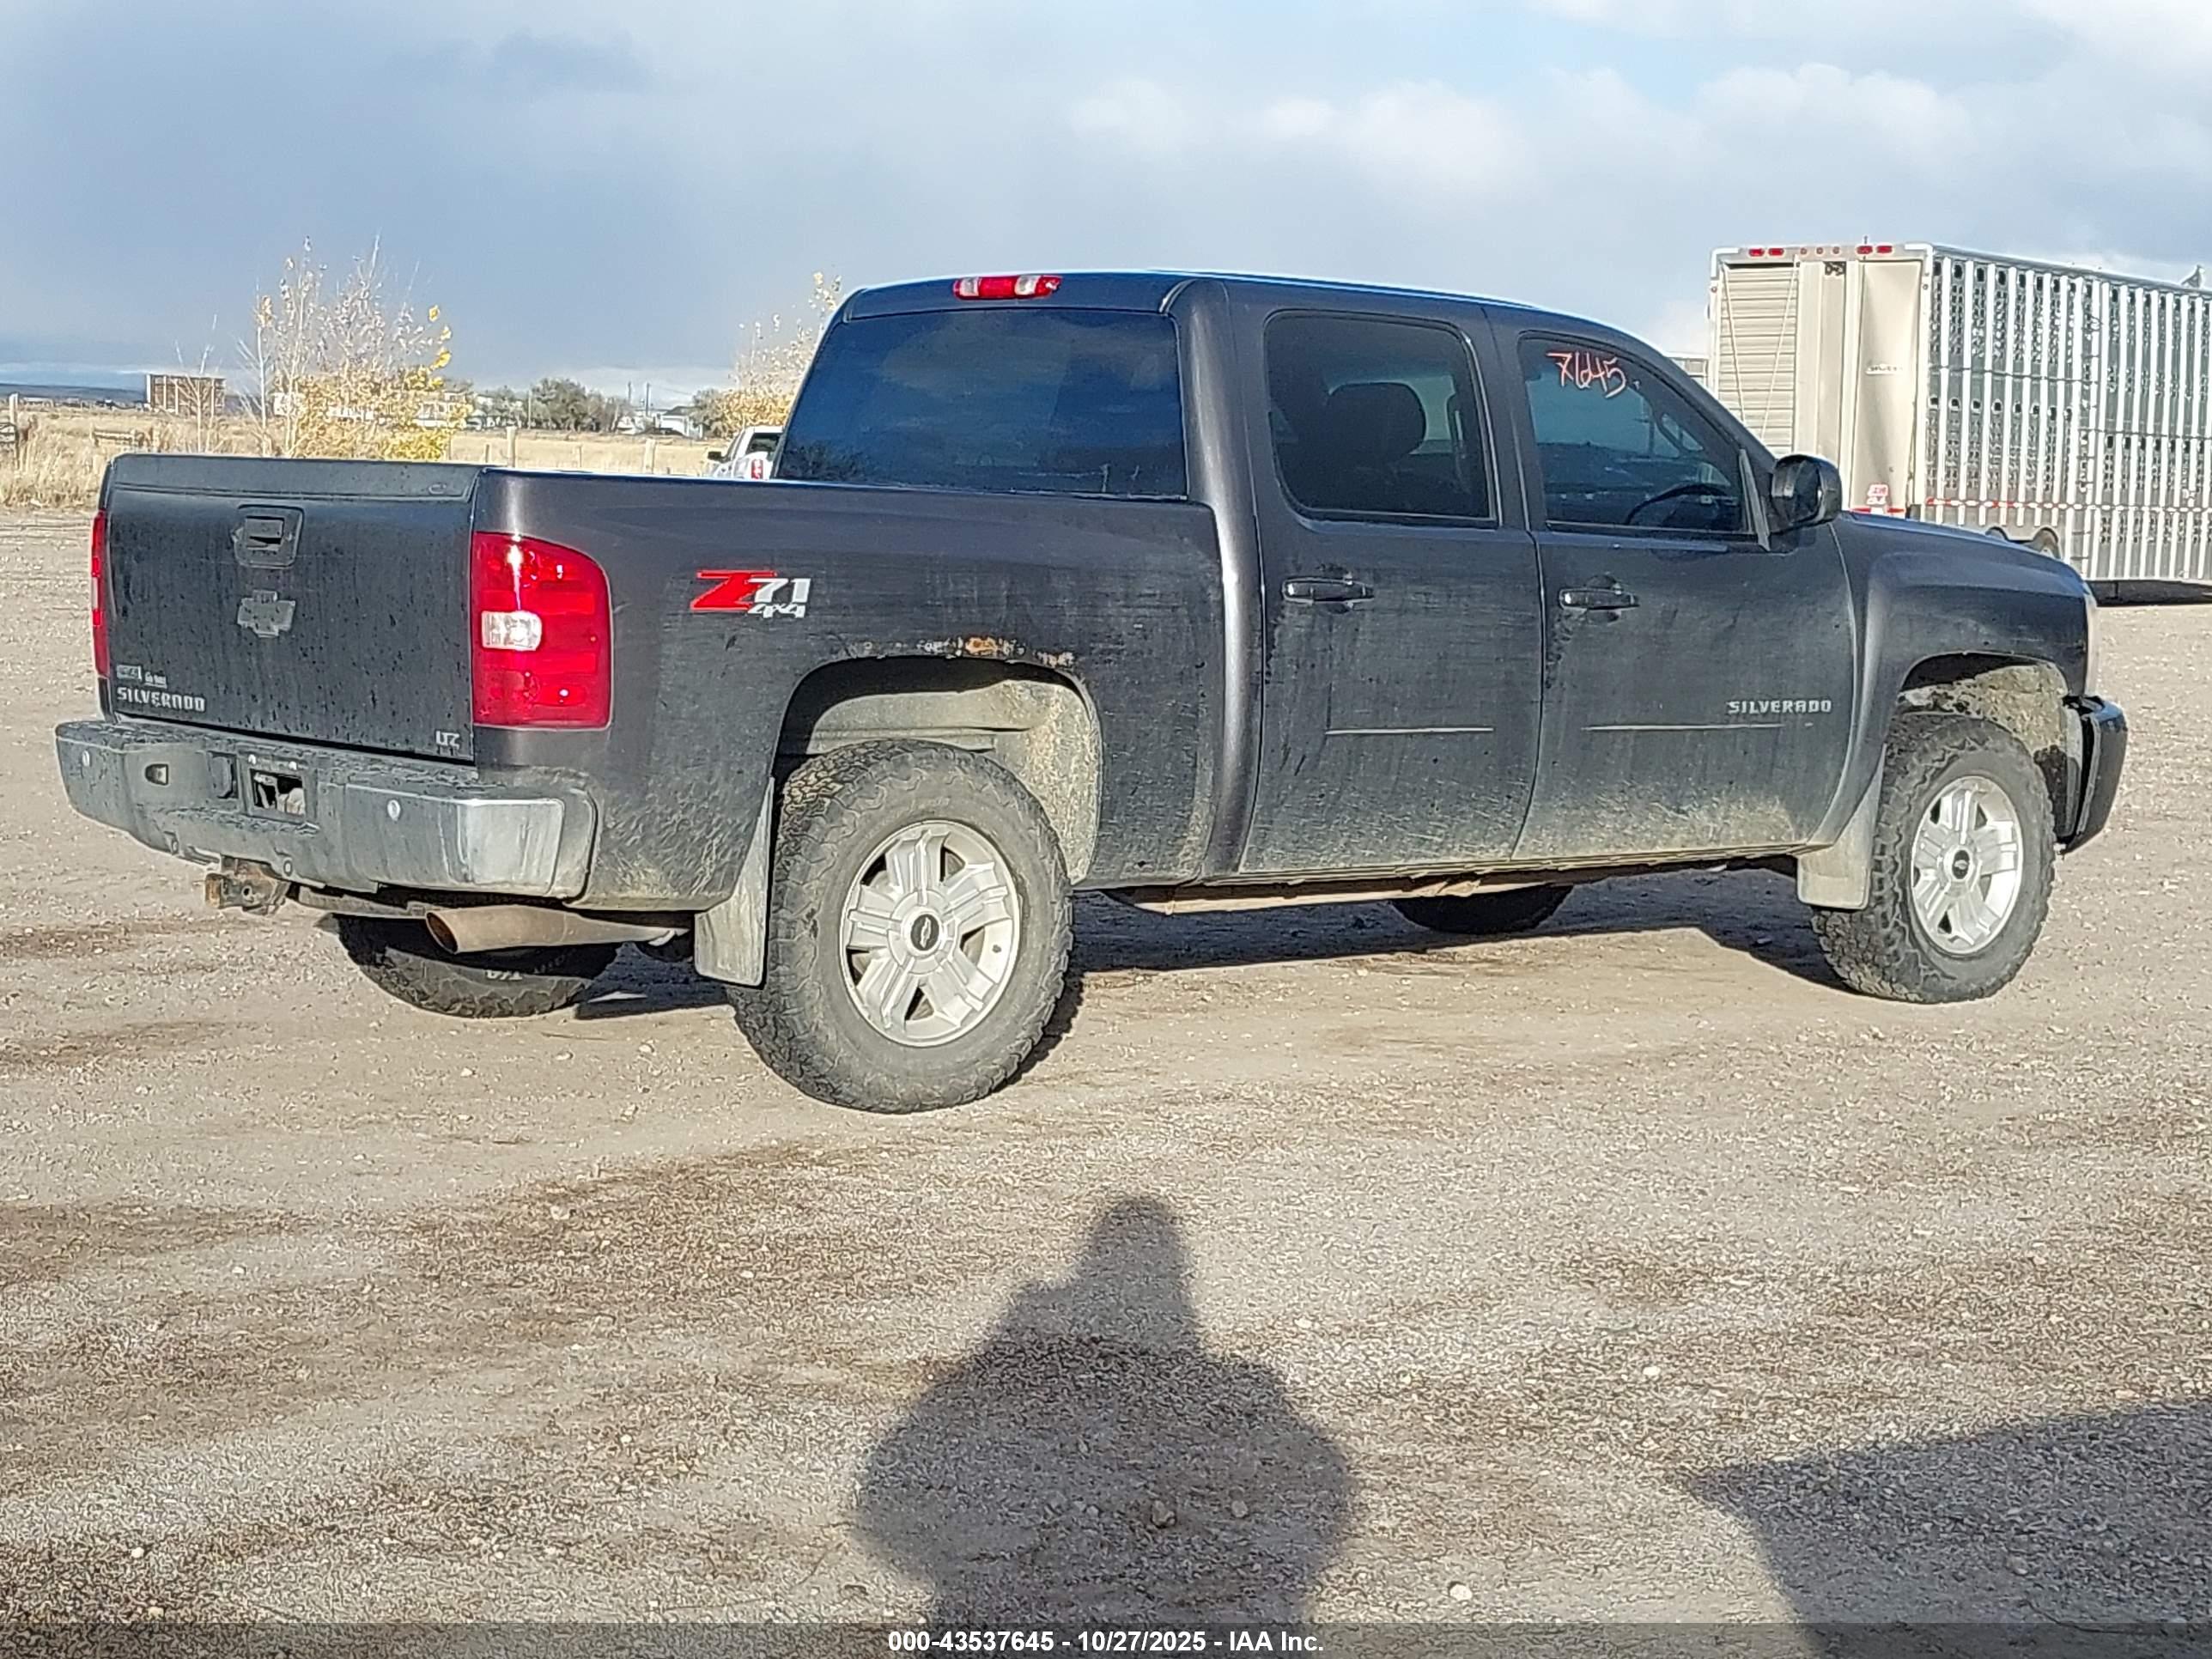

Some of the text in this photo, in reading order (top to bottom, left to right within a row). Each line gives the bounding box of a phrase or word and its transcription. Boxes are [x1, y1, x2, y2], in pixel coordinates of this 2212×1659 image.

[690, 568, 811, 612] Z71
[117, 686, 205, 713] SILVERADO
[1727, 699, 1832, 714] SILVERADO
[435, 730, 461, 750] LTZ
